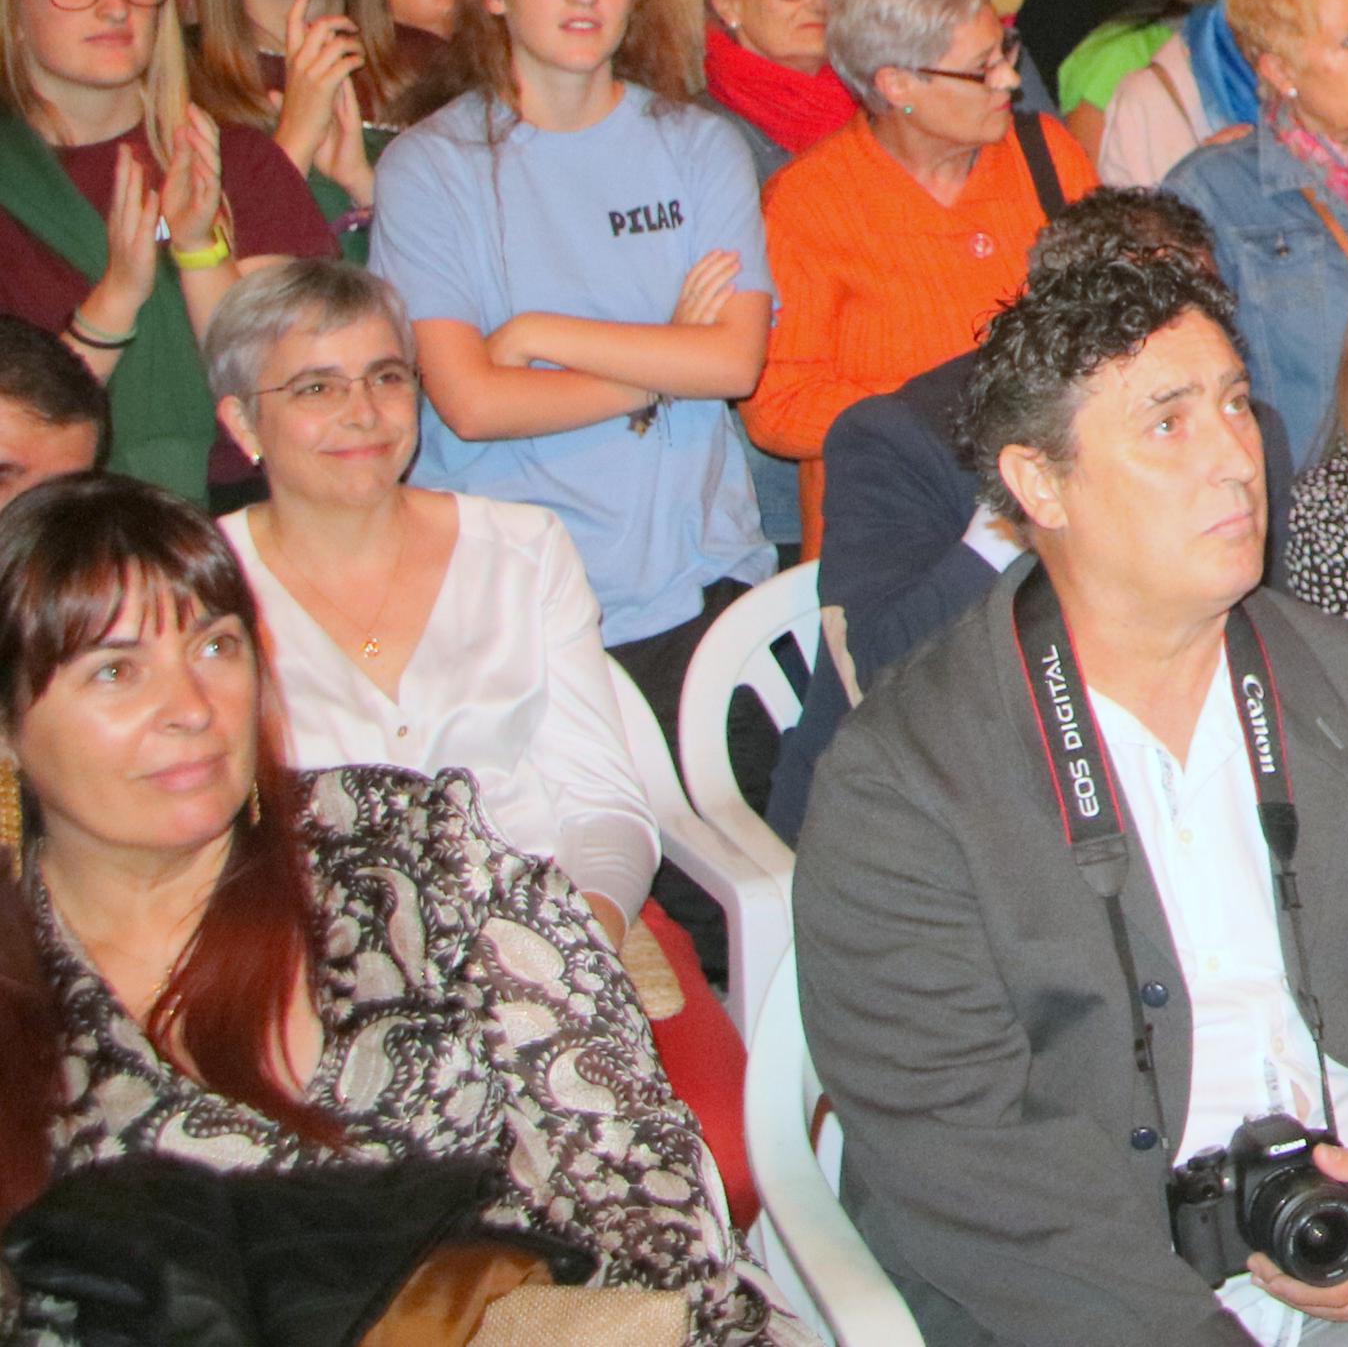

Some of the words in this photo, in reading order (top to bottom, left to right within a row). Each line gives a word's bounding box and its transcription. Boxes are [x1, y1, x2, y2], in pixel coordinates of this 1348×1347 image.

[608, 200, 684, 236] PILAR
[1042, 644, 1083, 751] DIGITAL
[1241, 674, 1276, 774] Canon
[1069, 758, 1100, 818] EOS
